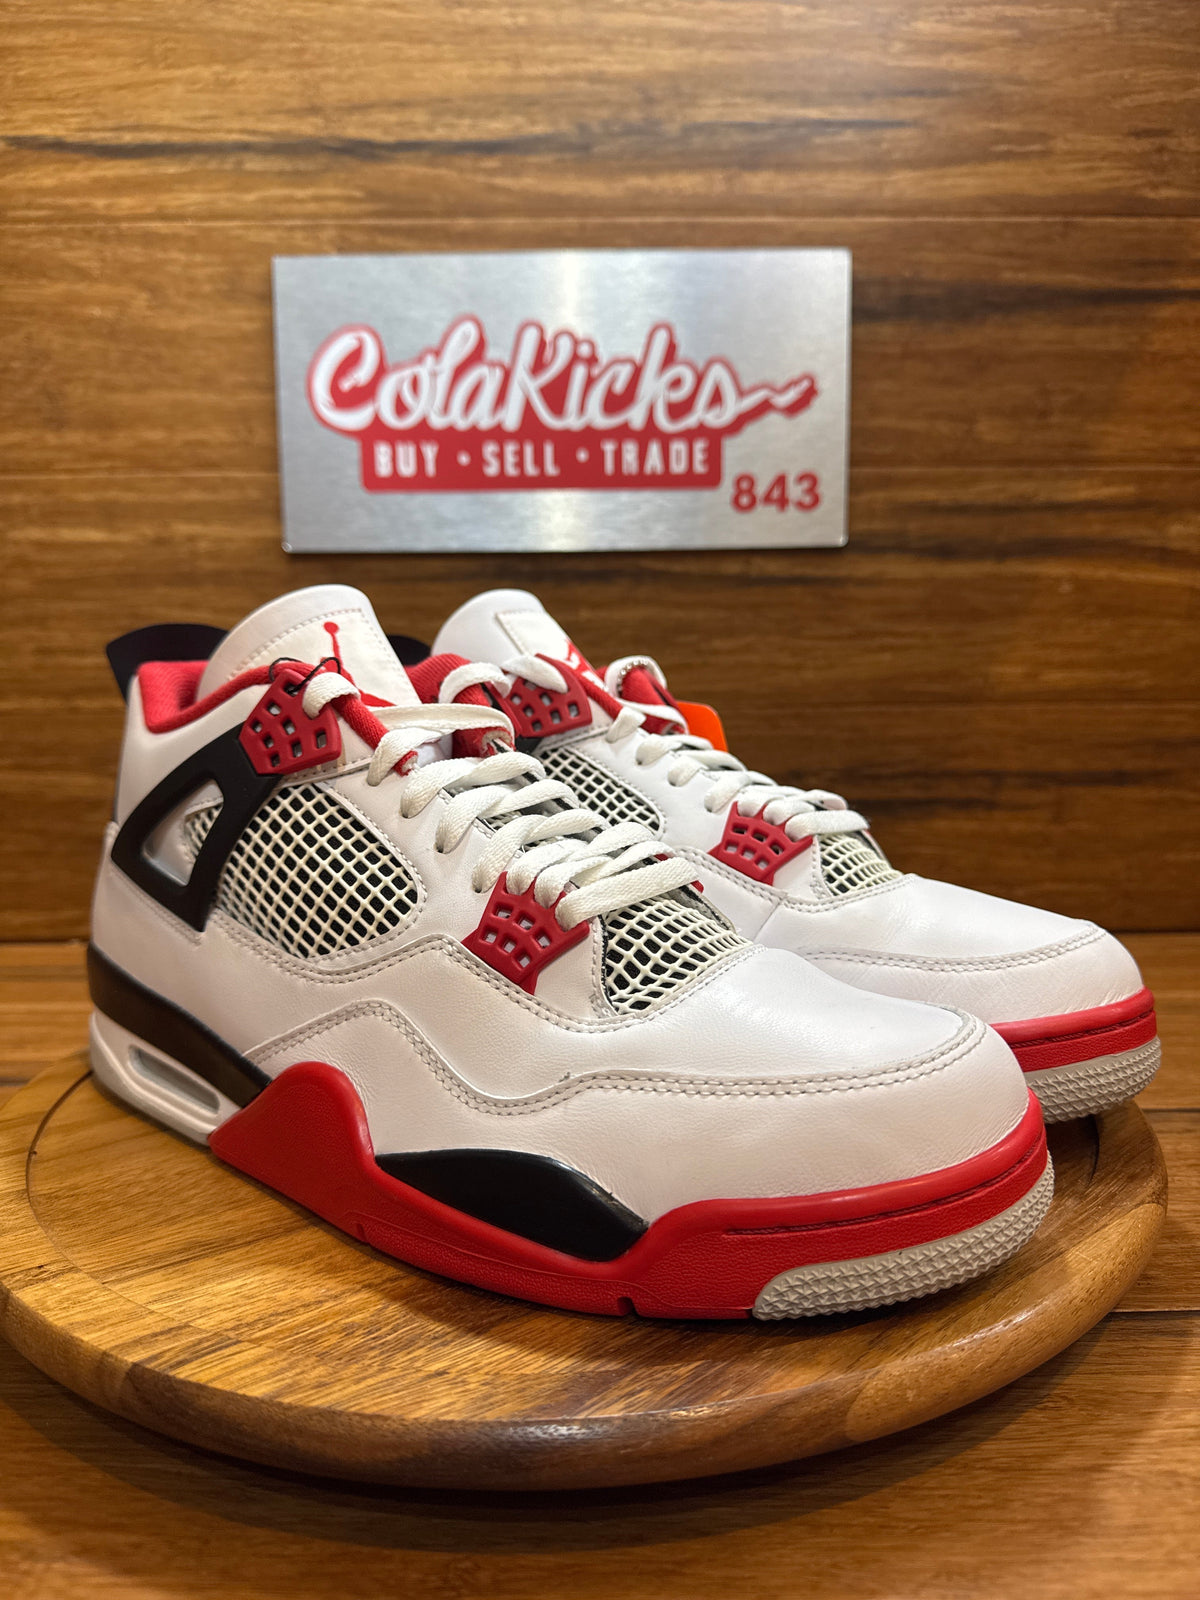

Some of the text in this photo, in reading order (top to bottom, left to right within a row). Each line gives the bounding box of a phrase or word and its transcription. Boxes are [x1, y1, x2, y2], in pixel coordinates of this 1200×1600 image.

[310, 318, 815, 433] ColaKicks
[374, 438, 710, 478] BUY SELL TRADE
[731, 472, 821, 514] 843
